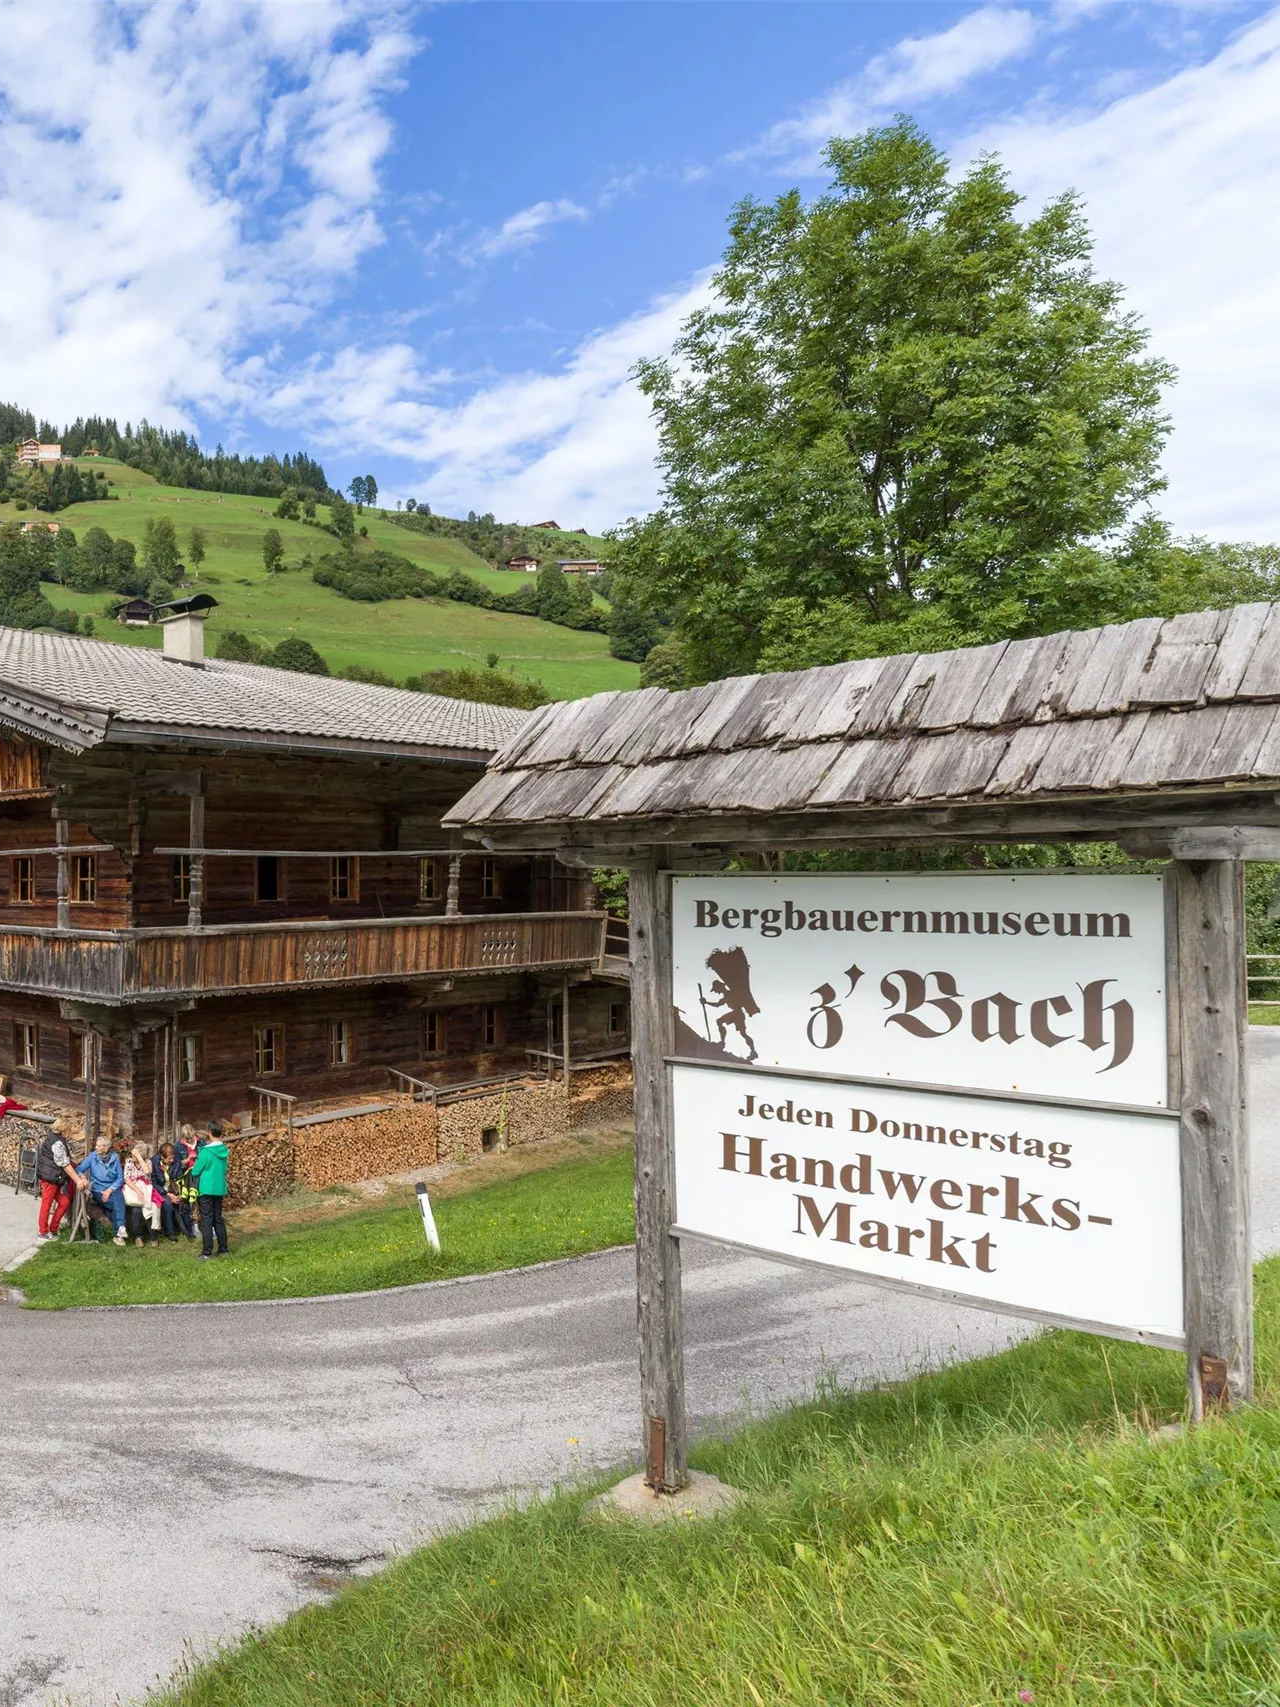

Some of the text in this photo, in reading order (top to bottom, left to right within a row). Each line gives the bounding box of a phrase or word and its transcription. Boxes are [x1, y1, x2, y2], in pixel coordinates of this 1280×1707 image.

[692, 899, 1133, 939] Bergbauernmuseum
[738, 1094, 1073, 1169] Jeden Donnerstag
[718, 1131, 1113, 1231] Handwerks-
[792, 1193, 997, 1273] Markt
